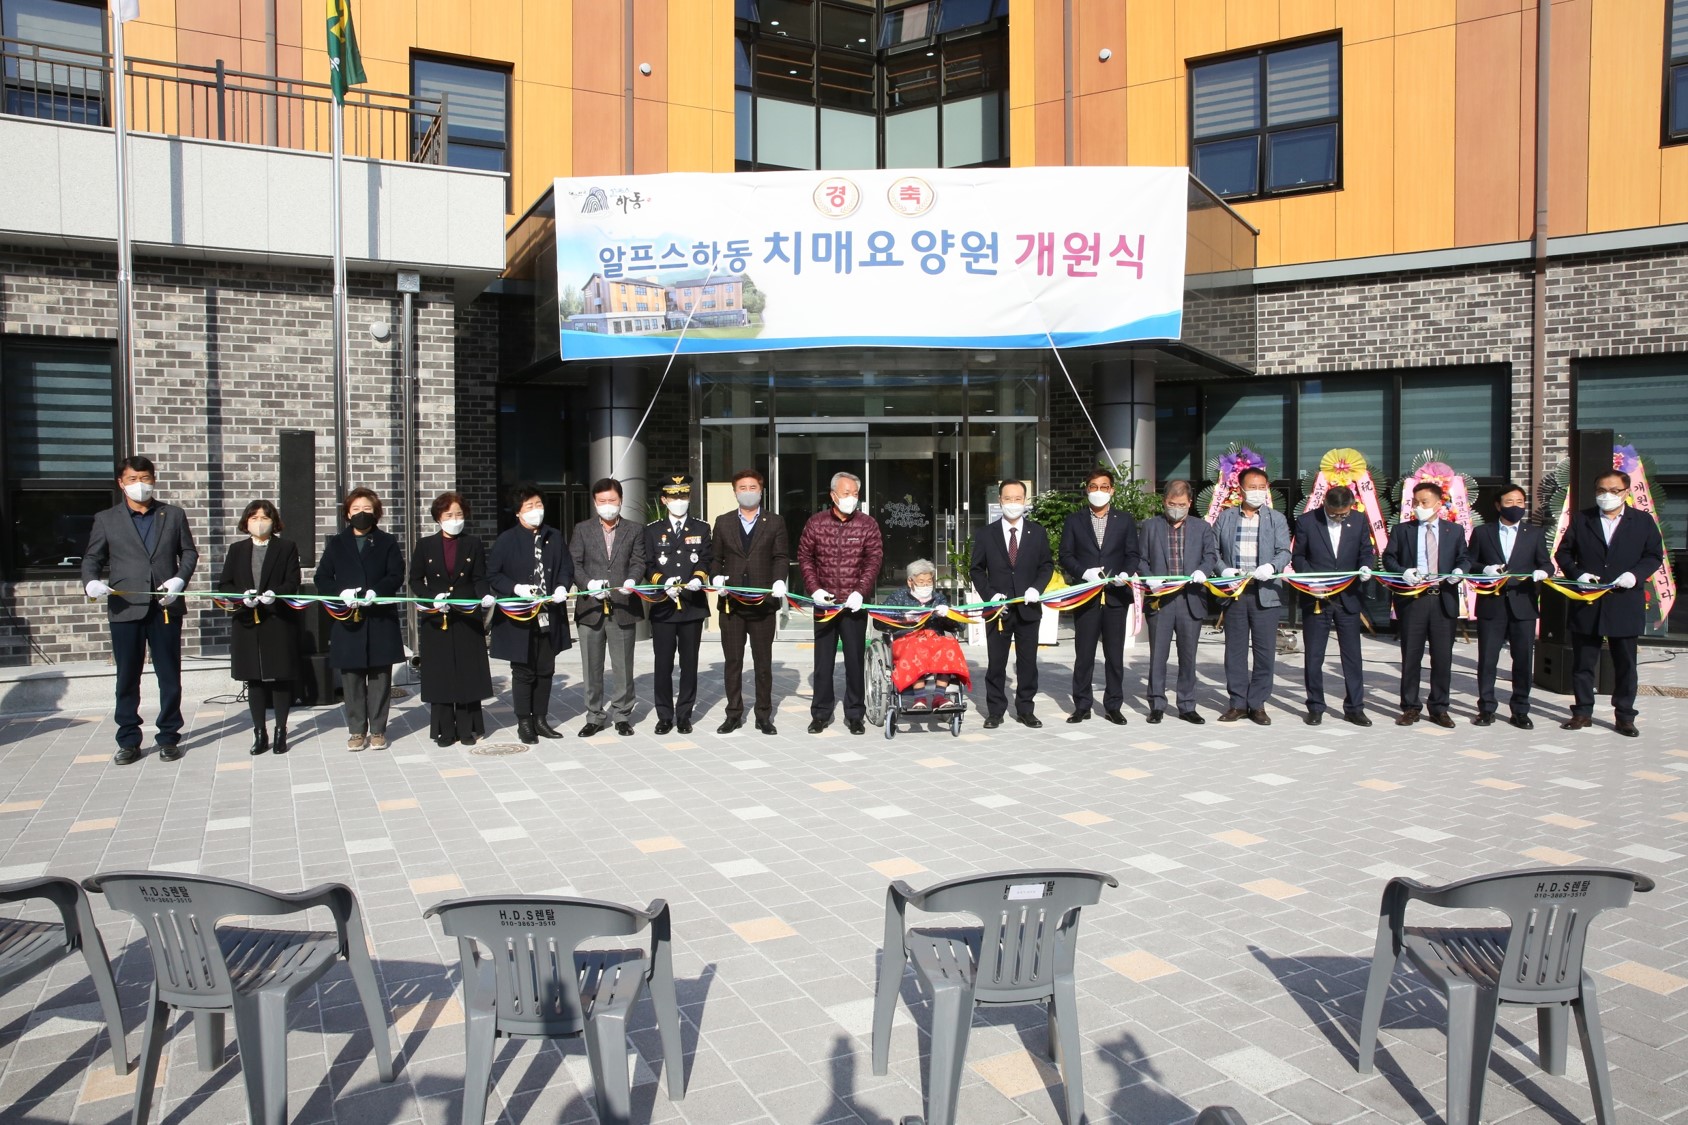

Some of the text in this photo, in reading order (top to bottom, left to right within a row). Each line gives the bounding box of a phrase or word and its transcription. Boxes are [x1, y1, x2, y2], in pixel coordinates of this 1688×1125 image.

[616, 192, 645, 214] 하동
[826, 185, 921, 208] 경 축
[598, 230, 1146, 280] 알프스하동 치매요양원 개원식
[138, 886, 189, 898] H.D.S렌탈
[1536, 880, 1590, 892] H.D.S렌탈
[499, 909, 555, 921] H.D.S렌탈
